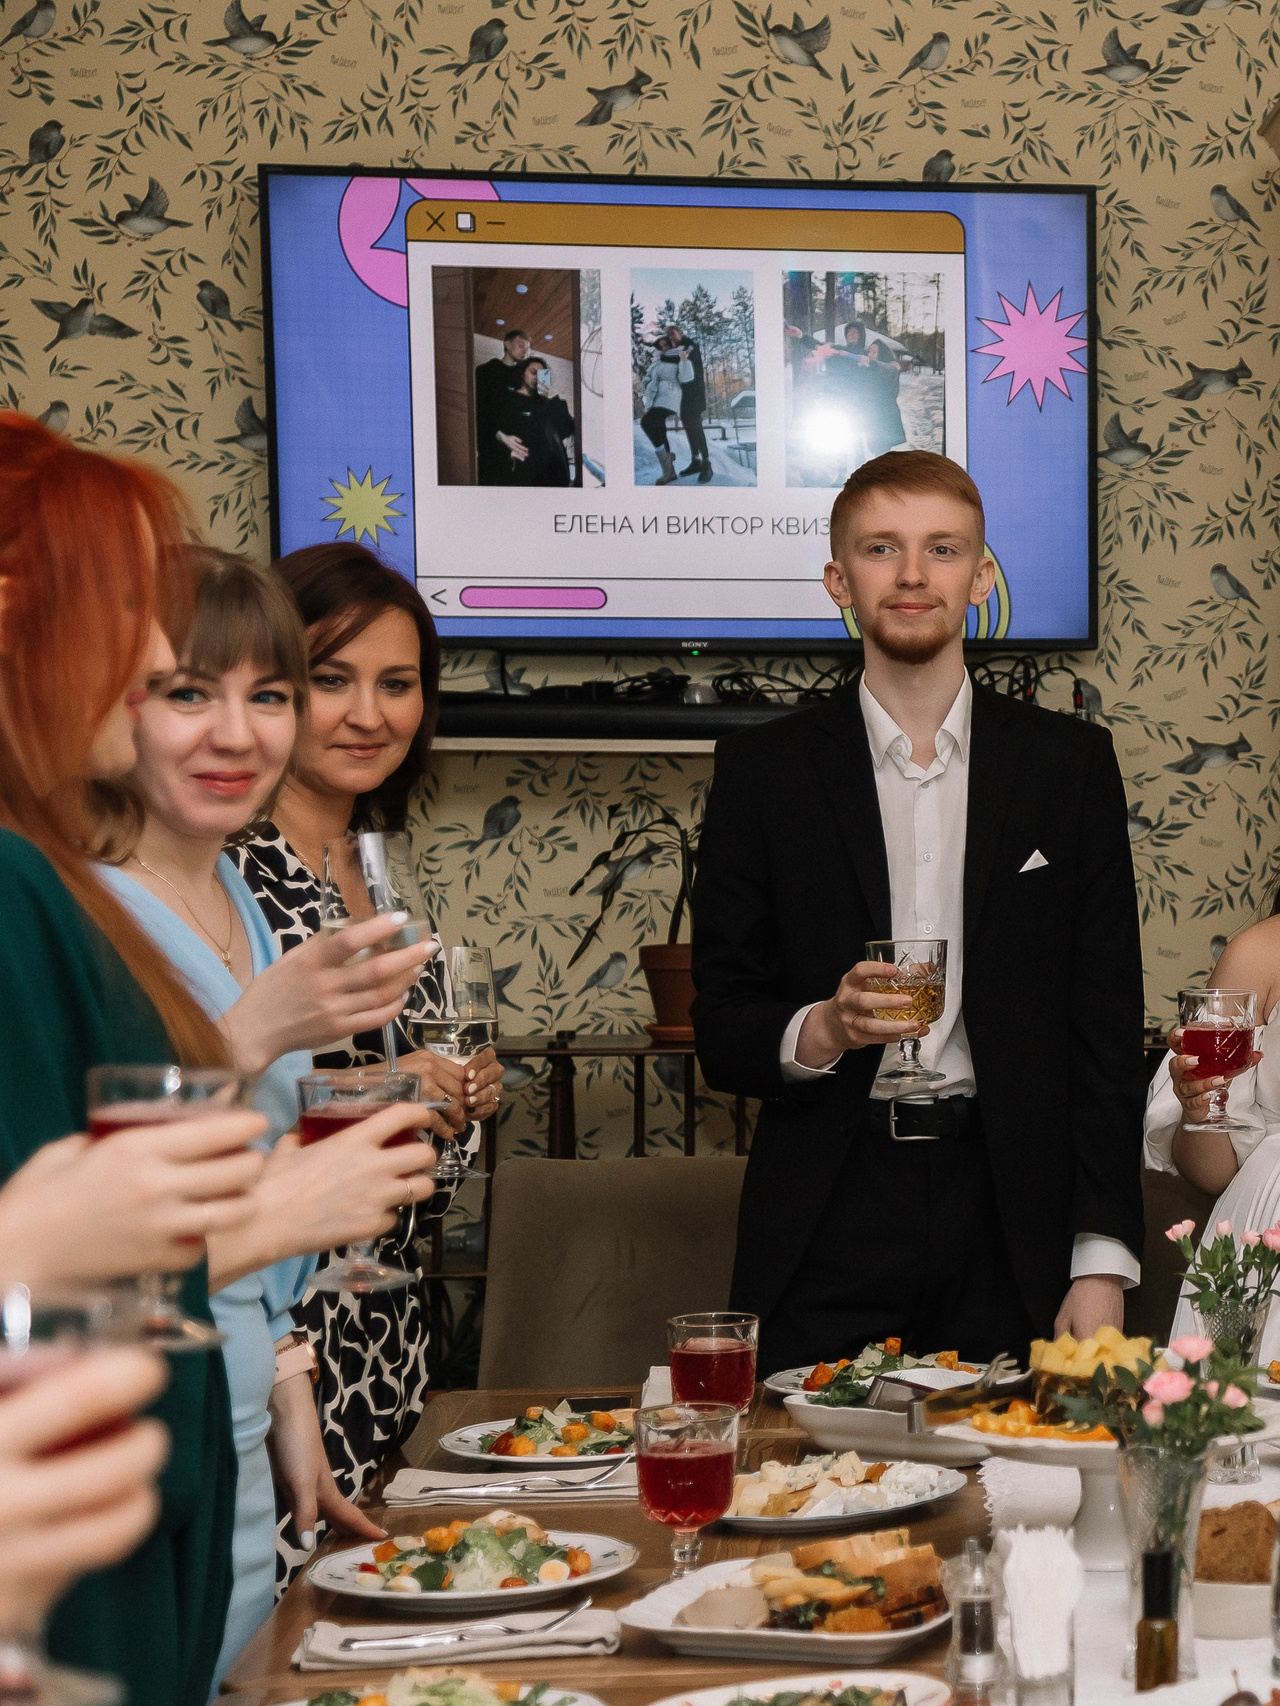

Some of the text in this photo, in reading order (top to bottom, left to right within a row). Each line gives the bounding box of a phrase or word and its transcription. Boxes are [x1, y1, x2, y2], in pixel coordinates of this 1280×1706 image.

[553, 514, 635, 534] ЕЛЕНА
[642, 515, 658, 535] И
[666, 515, 764, 536] ВИКТОР
